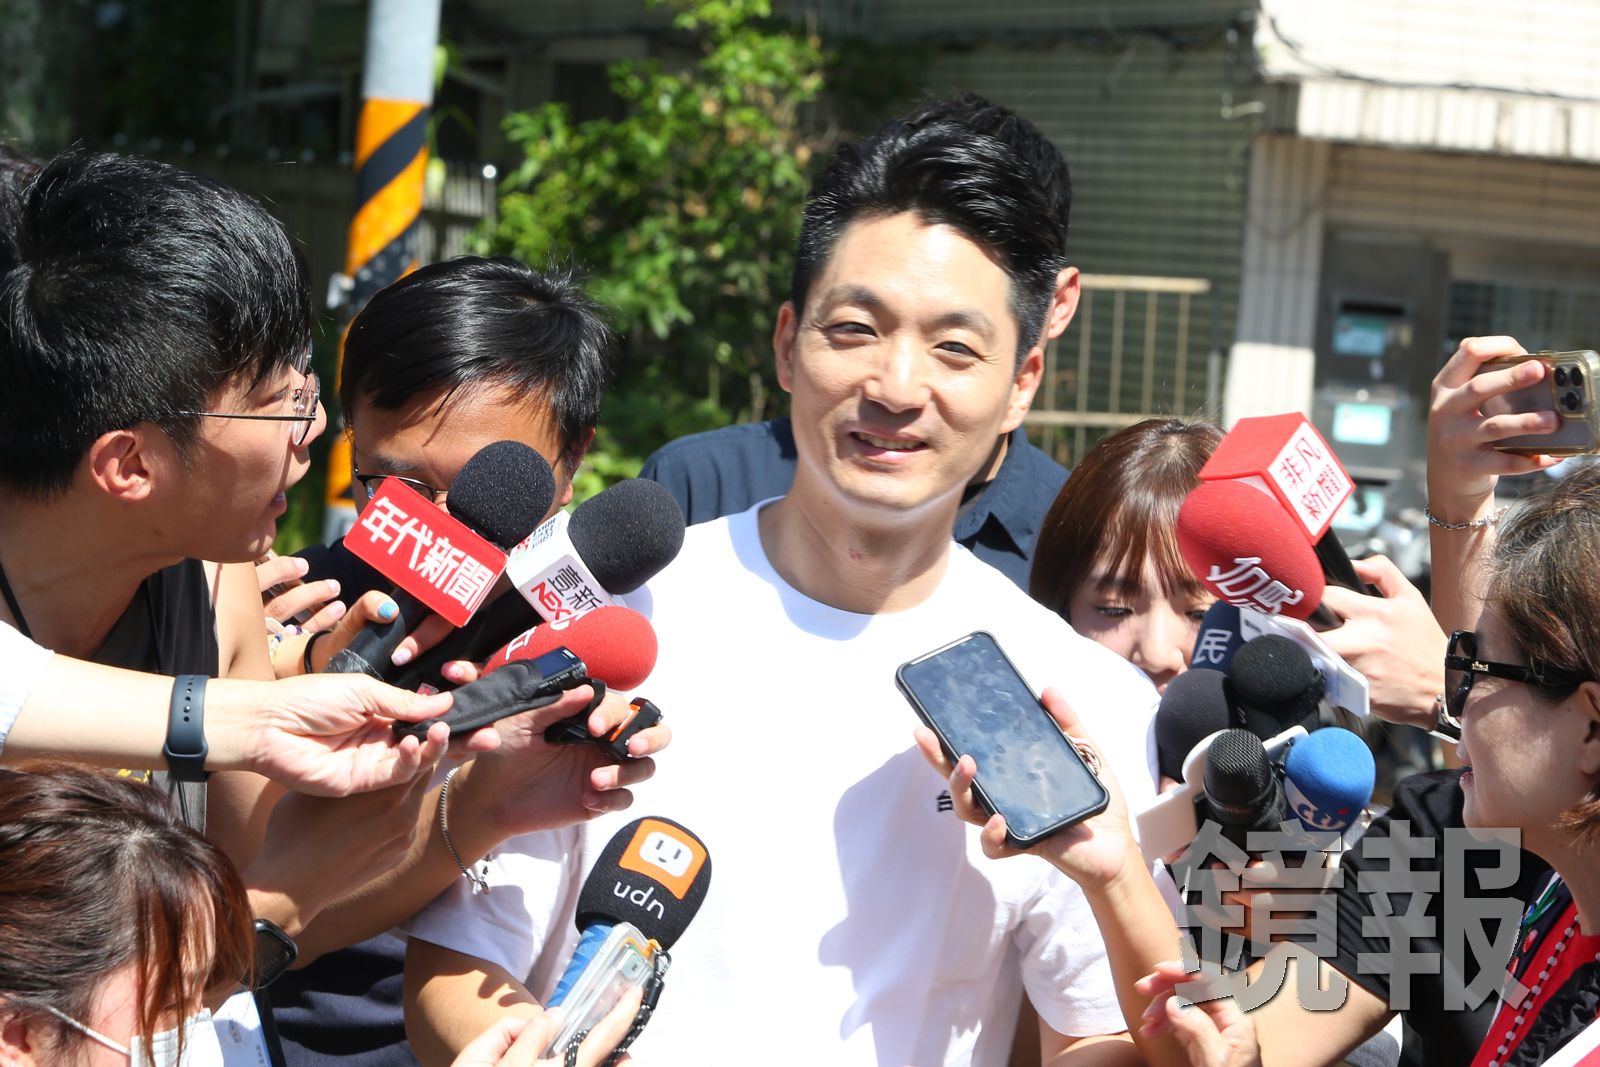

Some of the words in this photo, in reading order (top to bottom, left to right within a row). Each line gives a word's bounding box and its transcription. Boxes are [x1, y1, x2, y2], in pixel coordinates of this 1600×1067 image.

[1277, 437, 1322, 491] 非凡
[360, 497, 498, 614] 年代新聞
[530, 581, 573, 621] NEX
[547, 564, 603, 611] 壹新
[1192, 628, 1233, 665] 民
[613, 881, 665, 920] udn
